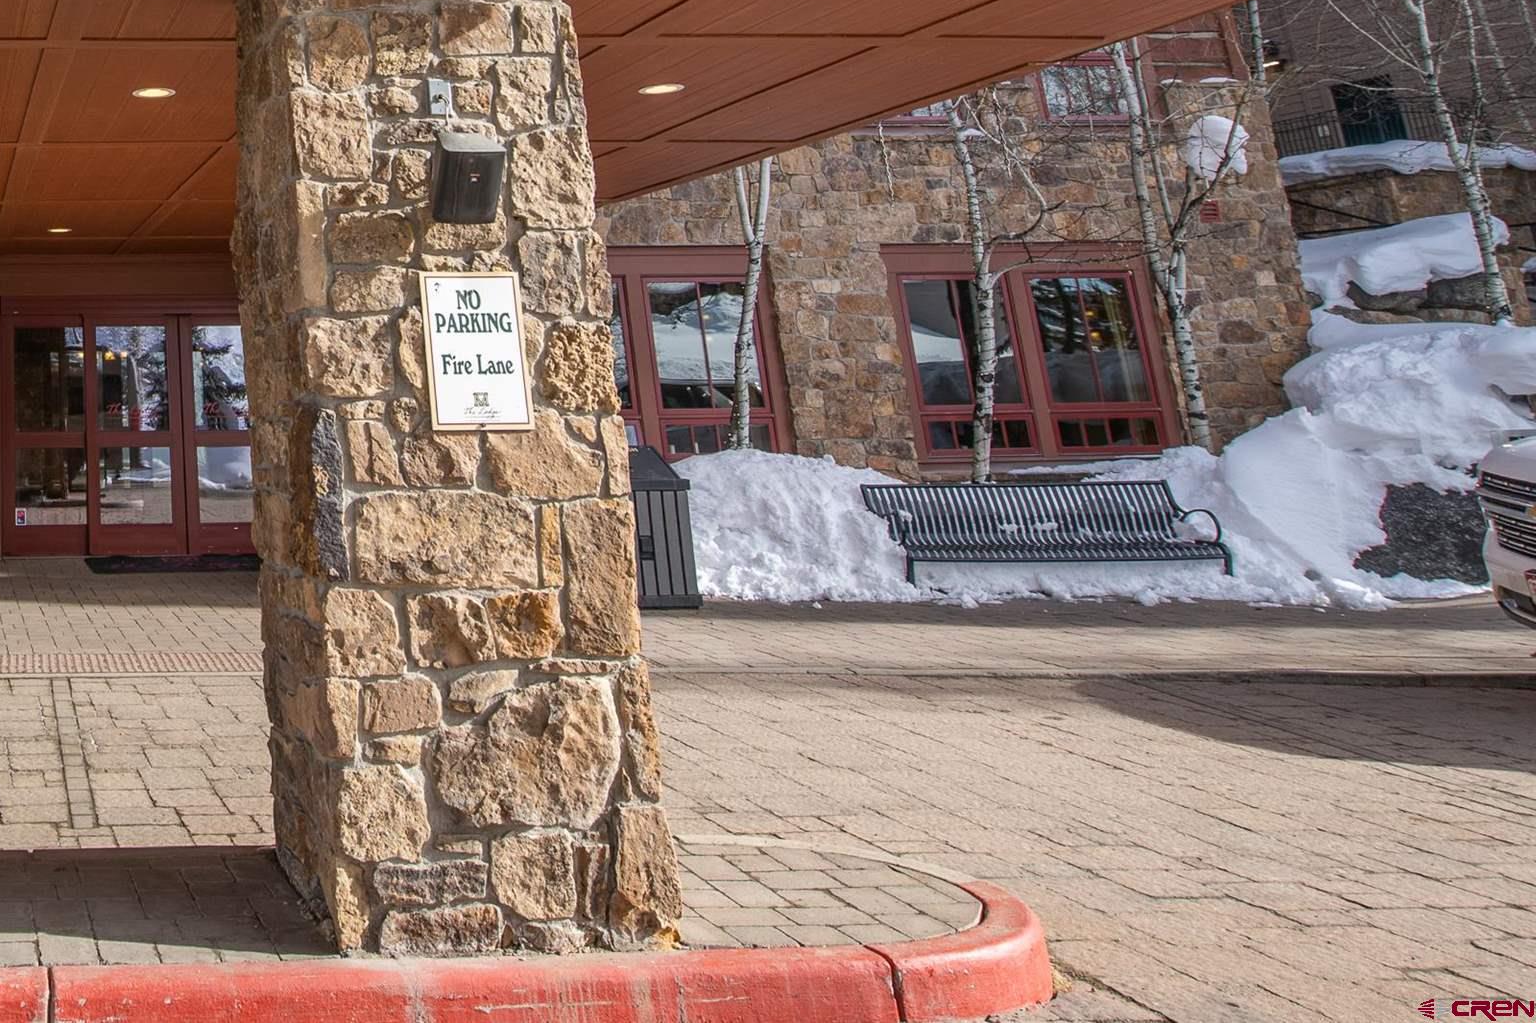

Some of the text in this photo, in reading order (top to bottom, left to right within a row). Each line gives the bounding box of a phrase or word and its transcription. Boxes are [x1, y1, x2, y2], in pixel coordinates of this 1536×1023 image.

[455, 289, 482, 311] NO
[435, 312, 513, 334] PARKING
[441, 353, 515, 375] Fire Lane
